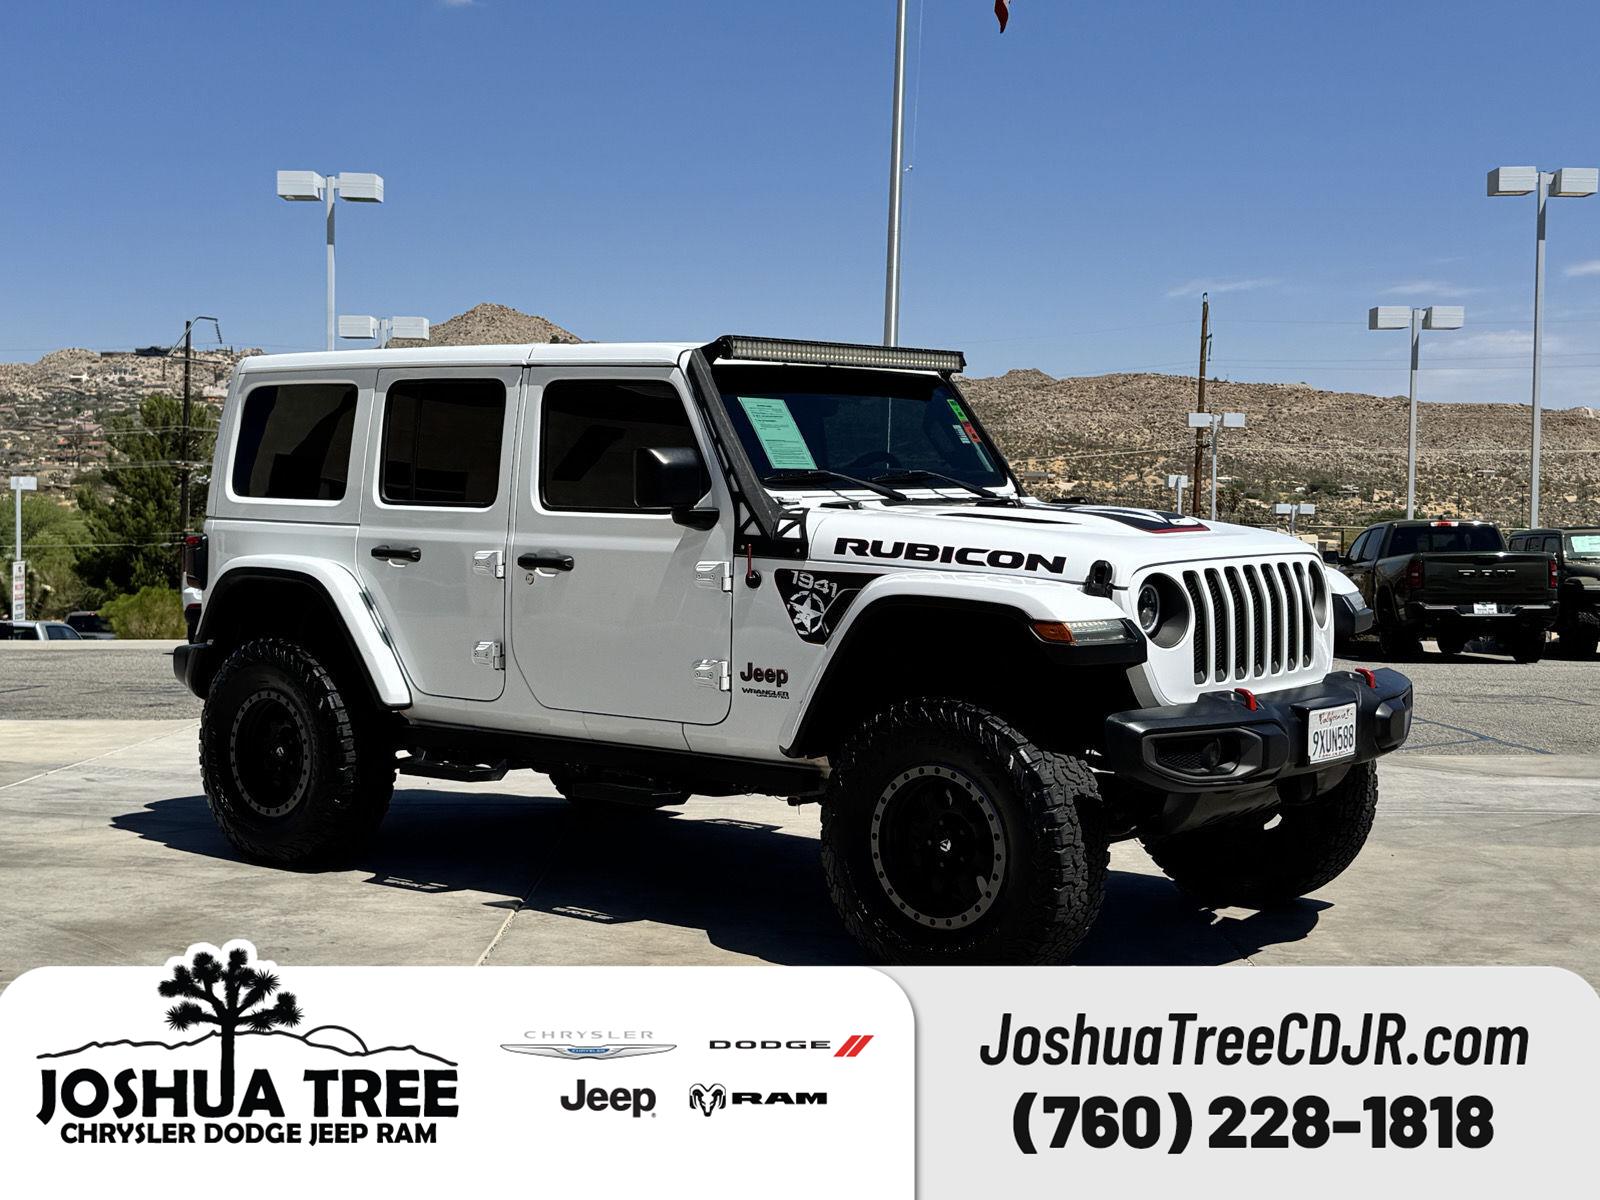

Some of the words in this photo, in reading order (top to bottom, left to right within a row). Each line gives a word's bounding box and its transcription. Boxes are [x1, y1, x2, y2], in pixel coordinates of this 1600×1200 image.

[833, 537, 1066, 574] RUBICON
[791, 570, 837, 598] 1941
[740, 662, 789, 687] Jeep
[741, 687, 789, 697] WRANGLER
[1312, 724, 1354, 758] 9XUN588
